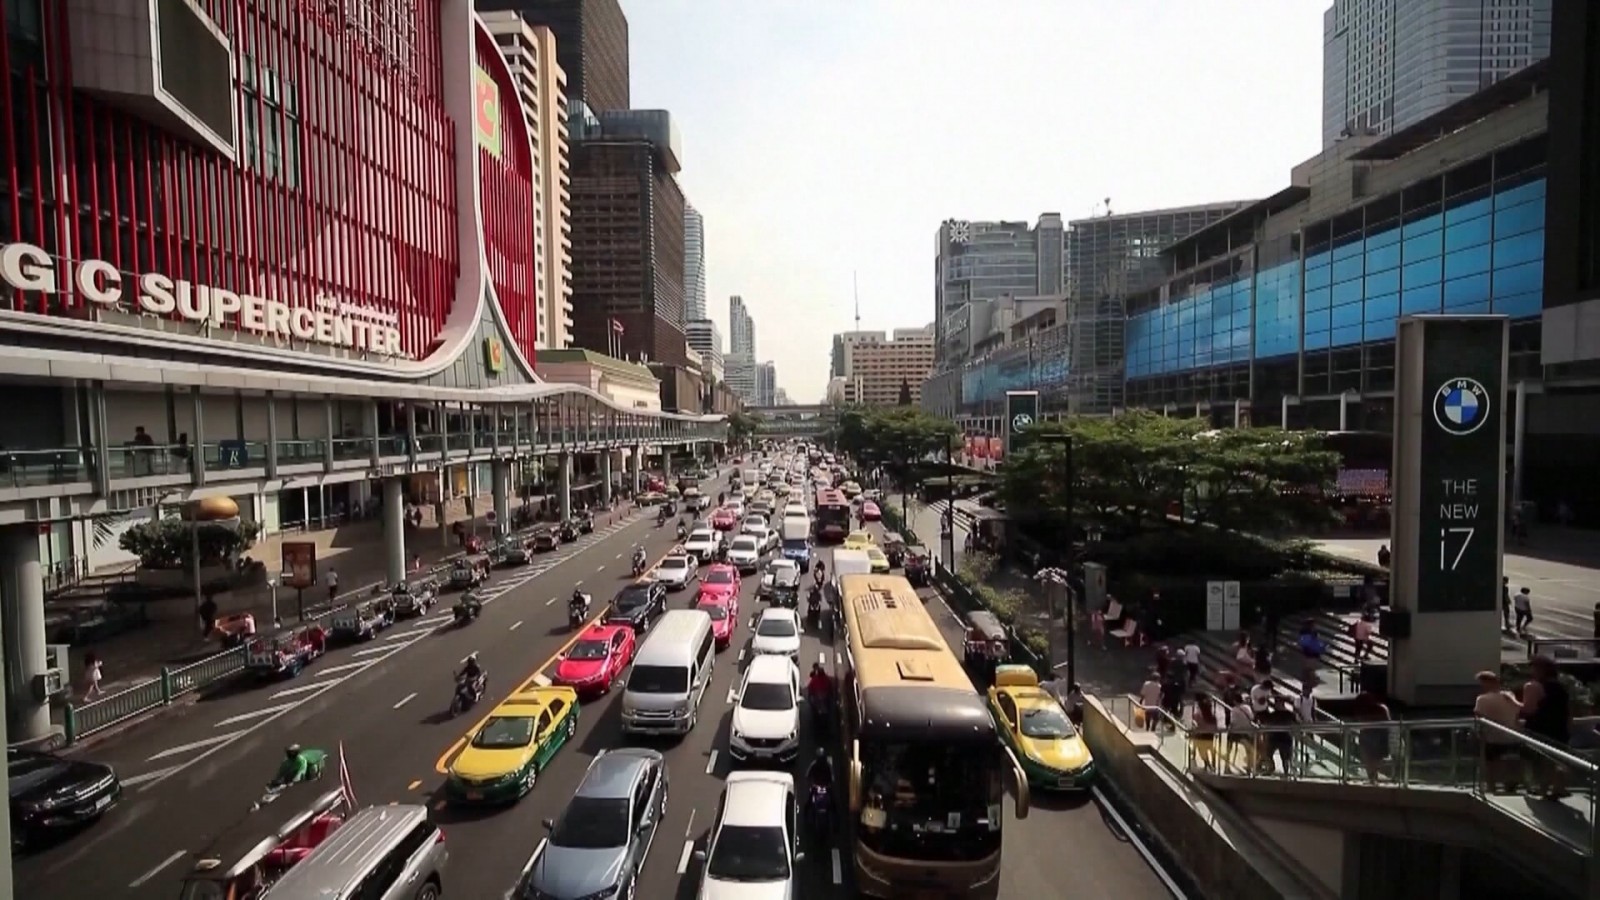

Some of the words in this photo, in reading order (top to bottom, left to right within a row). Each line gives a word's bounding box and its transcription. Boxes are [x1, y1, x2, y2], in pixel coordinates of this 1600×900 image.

[75, 258, 123, 304] C
[138, 271, 402, 354] SUPERCENTER
[1441, 380, 1482, 397] BMW
[1441, 478, 1478, 496] THE
[1440, 503, 1479, 519] NEW
[1440, 527, 1475, 571] i7
